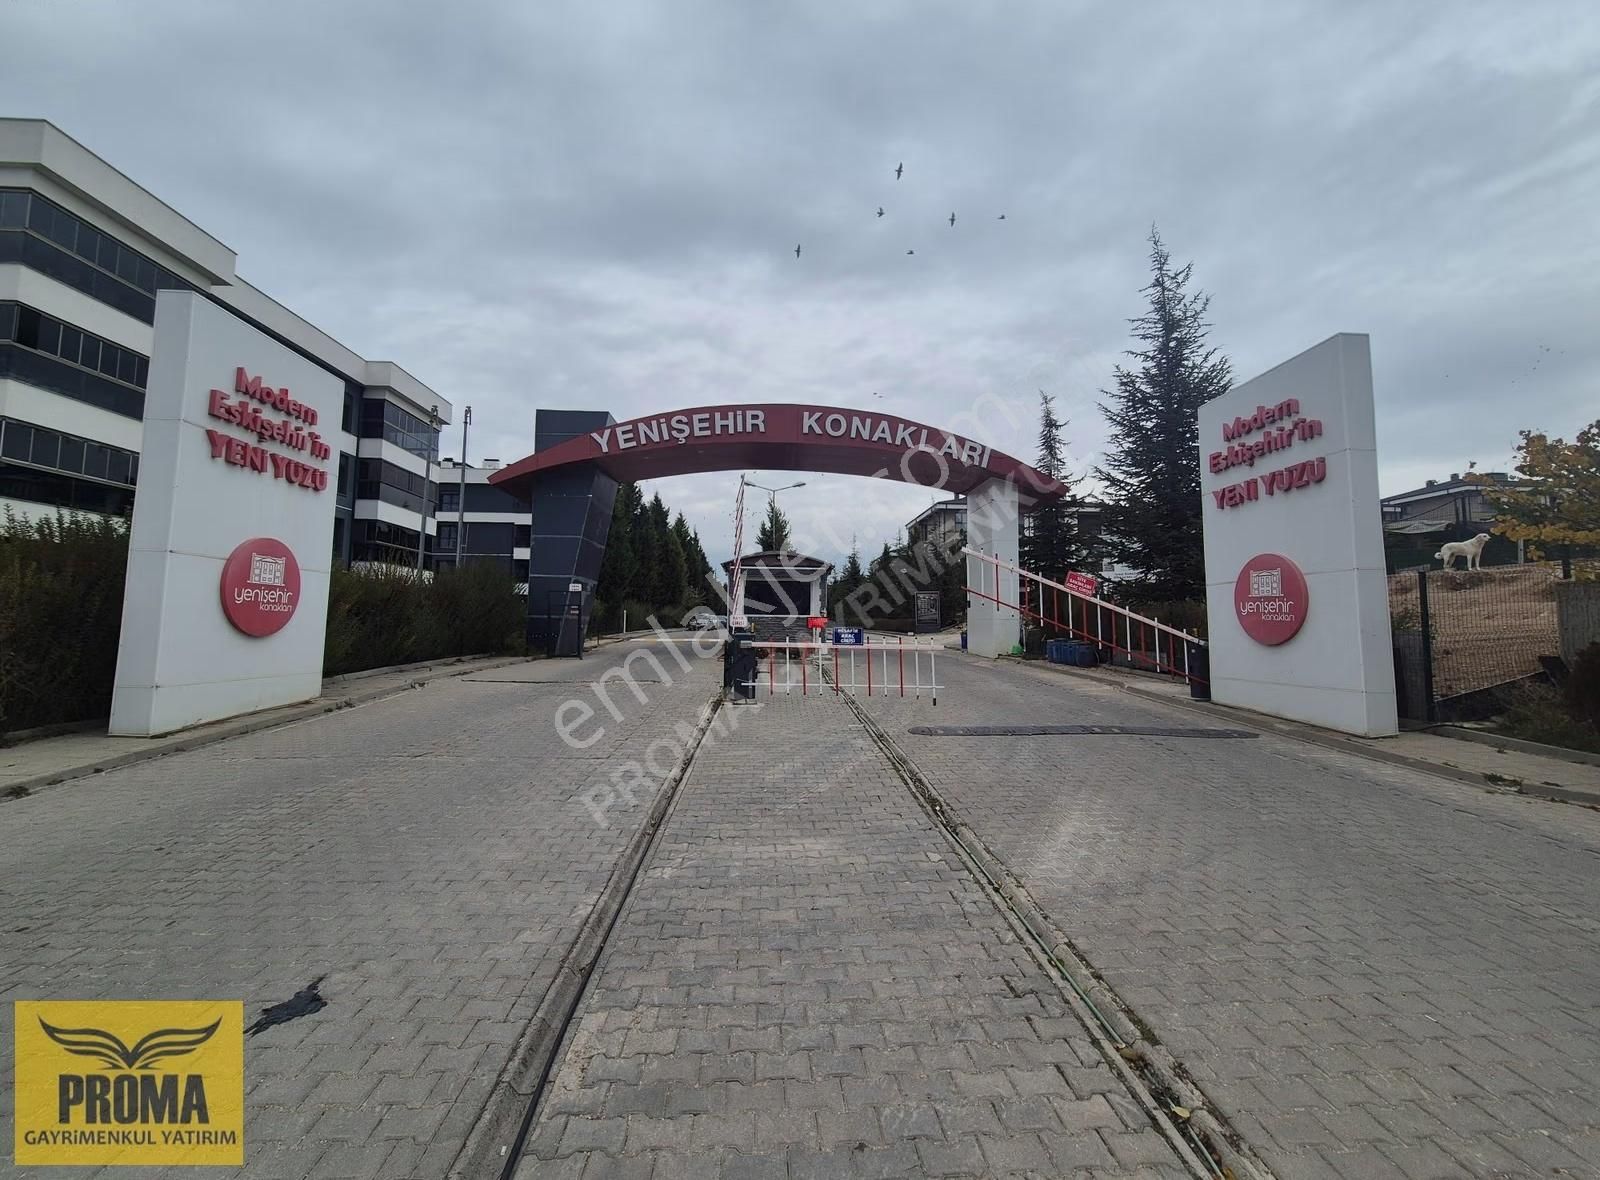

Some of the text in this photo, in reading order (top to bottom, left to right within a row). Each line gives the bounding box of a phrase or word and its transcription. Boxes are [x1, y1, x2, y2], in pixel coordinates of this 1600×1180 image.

[235, 366, 318, 426] Modern
[1222, 396, 1299, 442] Modern
[589, 408, 993, 469] YENİŞEHİR KONAKLARI
[234, 586, 293, 604] yenişehir
[1240, 597, 1295, 616] yenişehir
